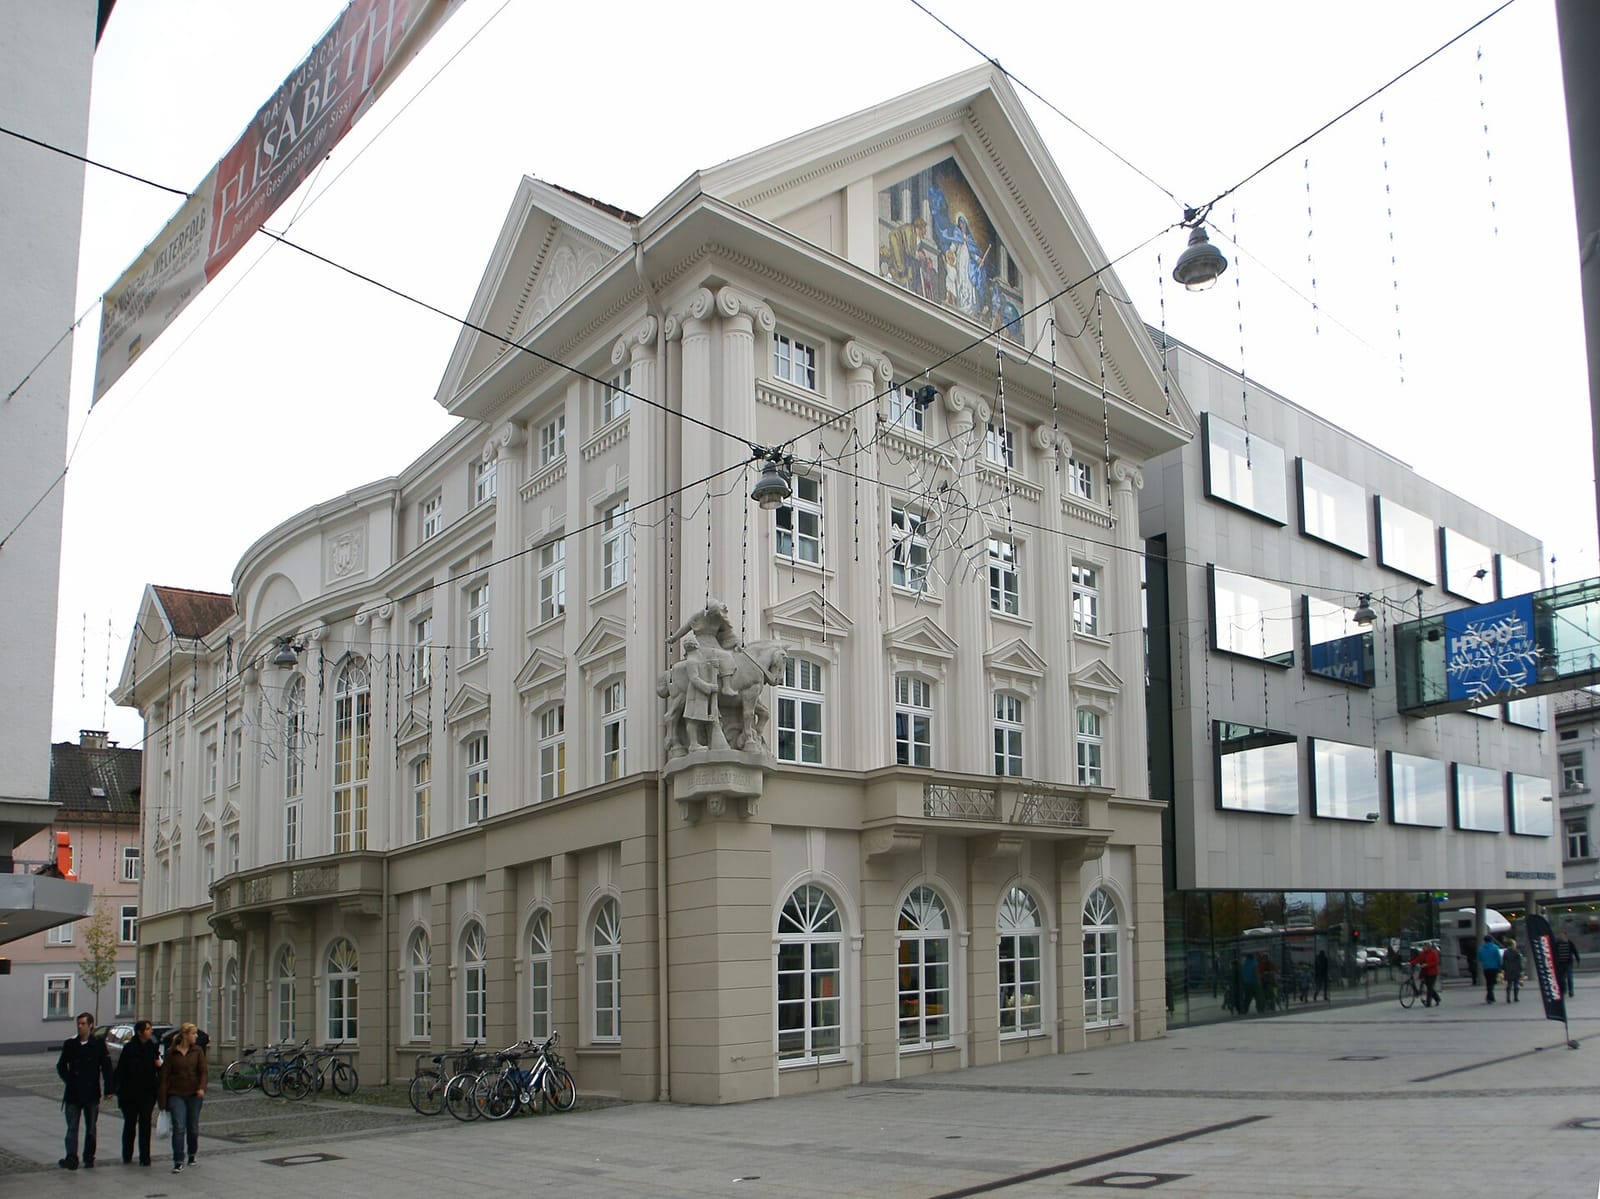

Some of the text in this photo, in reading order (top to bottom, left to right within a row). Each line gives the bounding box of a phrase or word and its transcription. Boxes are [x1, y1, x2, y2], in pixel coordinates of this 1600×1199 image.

[213, 0, 395, 256] ELISABETH
[263, 30, 342, 128] DAS MUSICAL
[266, 142, 312, 197] Geschichte
[314, 122, 328, 147] der
[330, 93, 353, 128] Sissi
